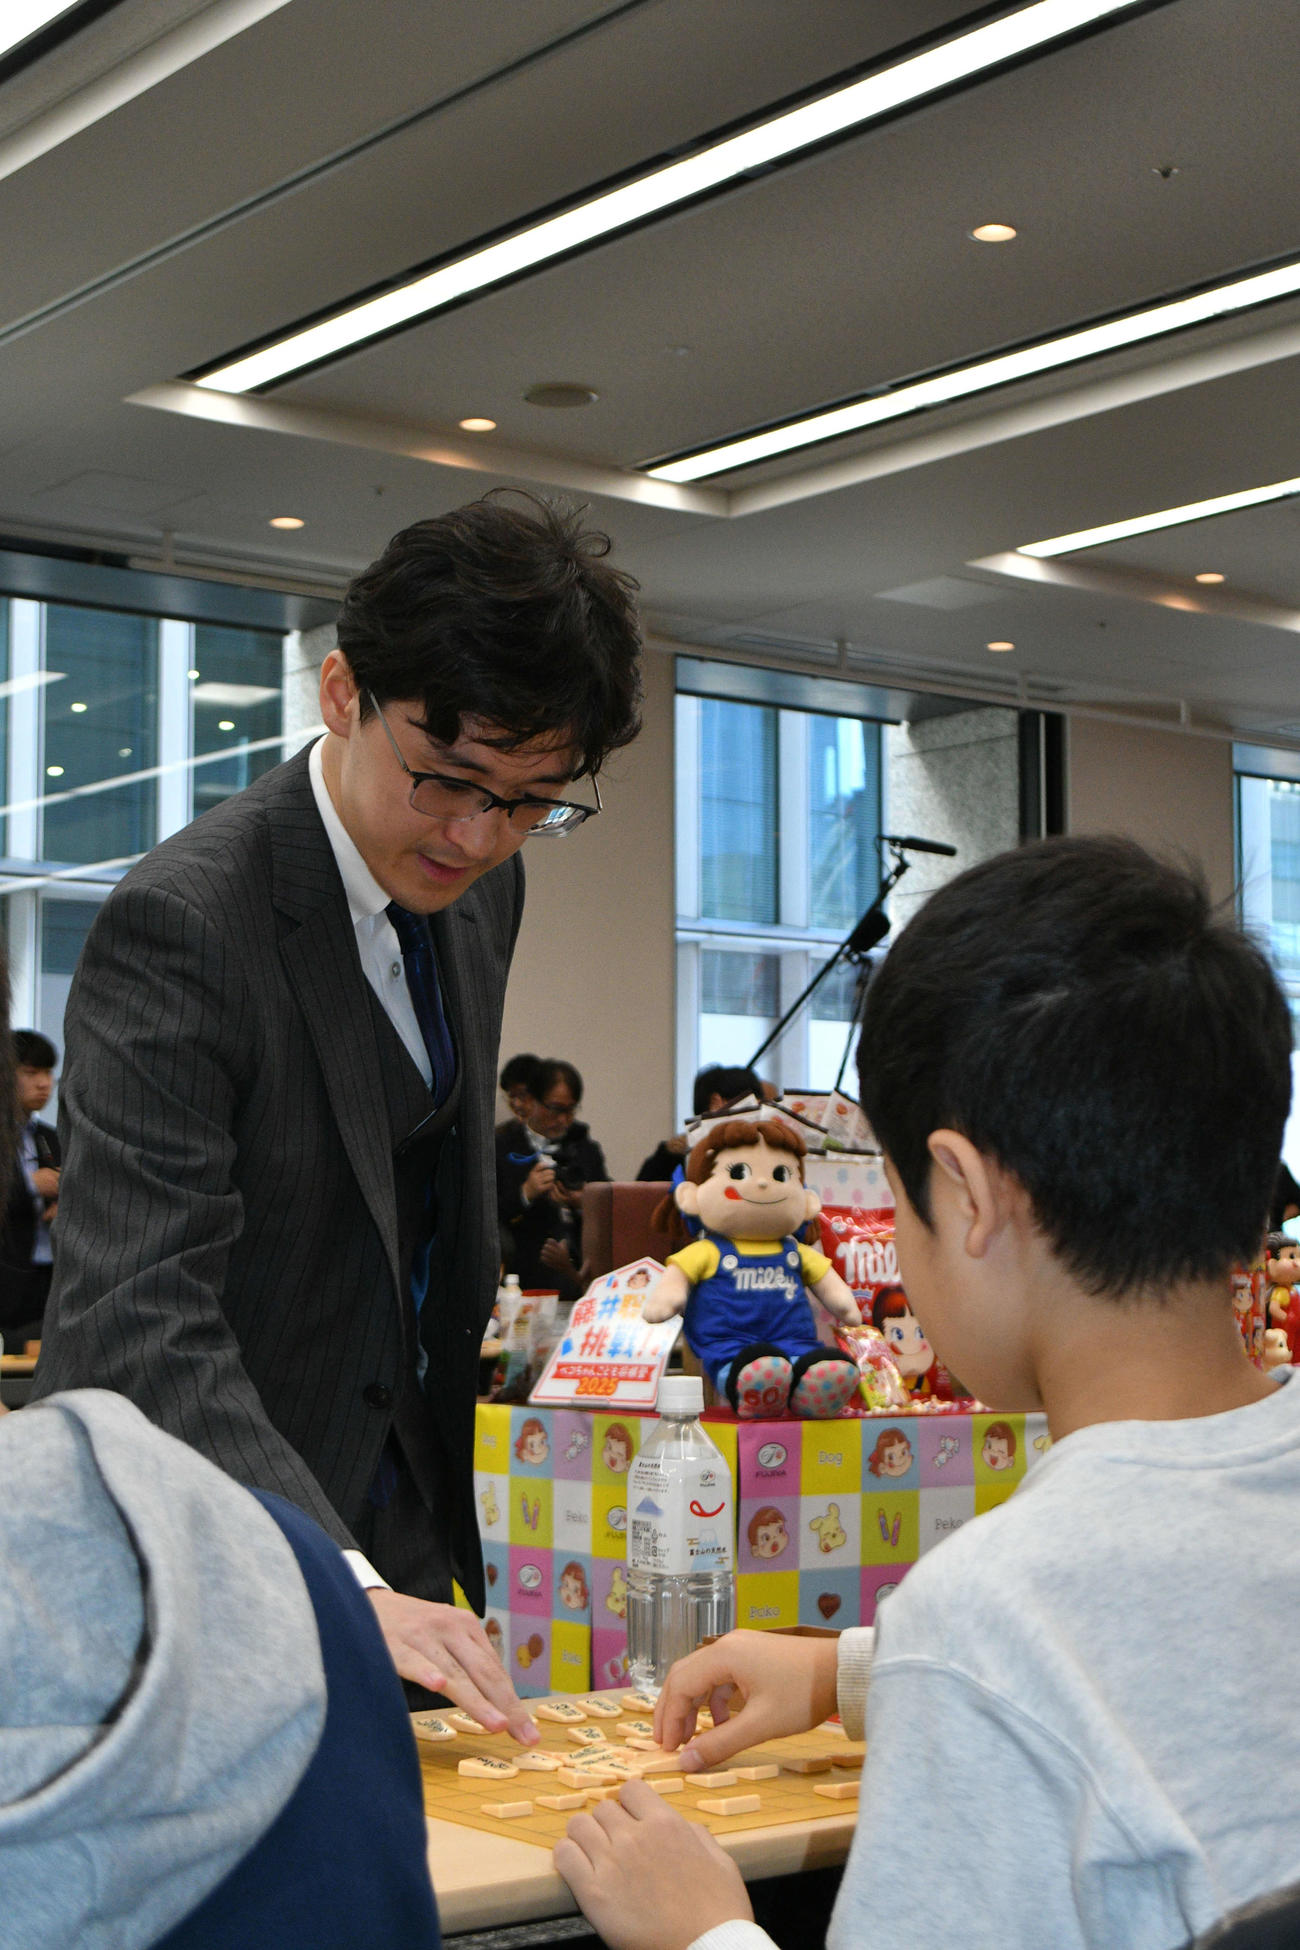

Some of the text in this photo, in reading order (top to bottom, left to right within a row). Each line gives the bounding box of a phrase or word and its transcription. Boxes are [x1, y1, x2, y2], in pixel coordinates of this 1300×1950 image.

[836, 1238, 901, 1284] Mil
[576, 1376, 619, 1395] 2025
[818, 1450, 843, 1467] Dog
